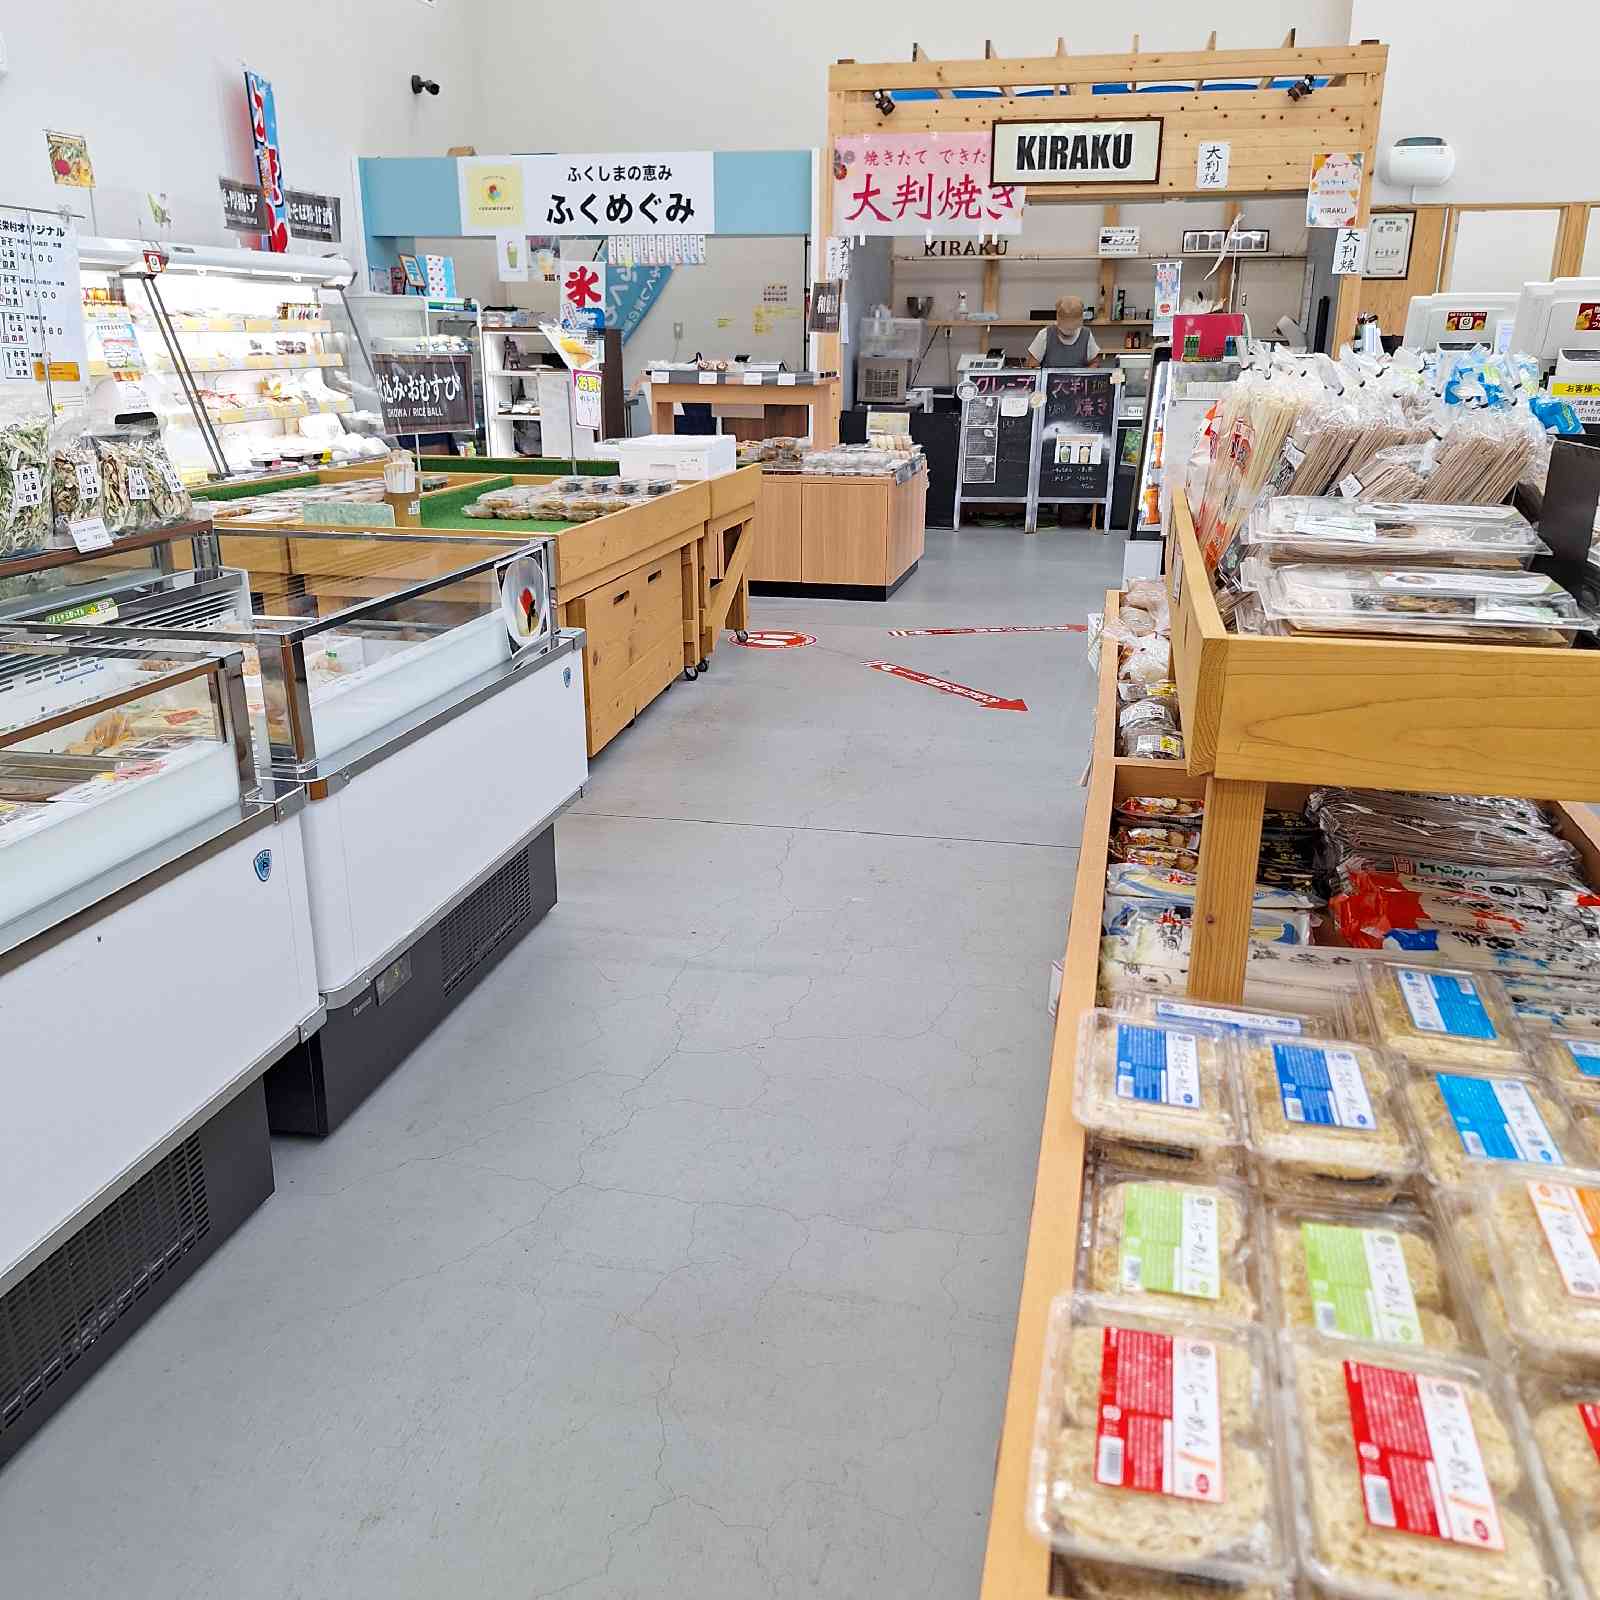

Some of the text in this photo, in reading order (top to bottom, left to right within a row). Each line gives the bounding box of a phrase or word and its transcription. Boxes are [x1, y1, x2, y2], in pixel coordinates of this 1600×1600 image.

[863, 147, 987, 167] 焼きたて できた
[1016, 133, 1133, 170] KIRAKU
[1202, 146, 1224, 184] 大判焼
[567, 165, 673, 182] ふくしまの恵み
[546, 192, 696, 225] ふくめぐみ
[845, 173, 1016, 222] 大判焼き
[923, 240, 1009, 257] KIRAKU
[1338, 229, 1361, 273] 大判焼
[564, 265, 602, 309] 氷
[974, 375, 1036, 396] クレープ
